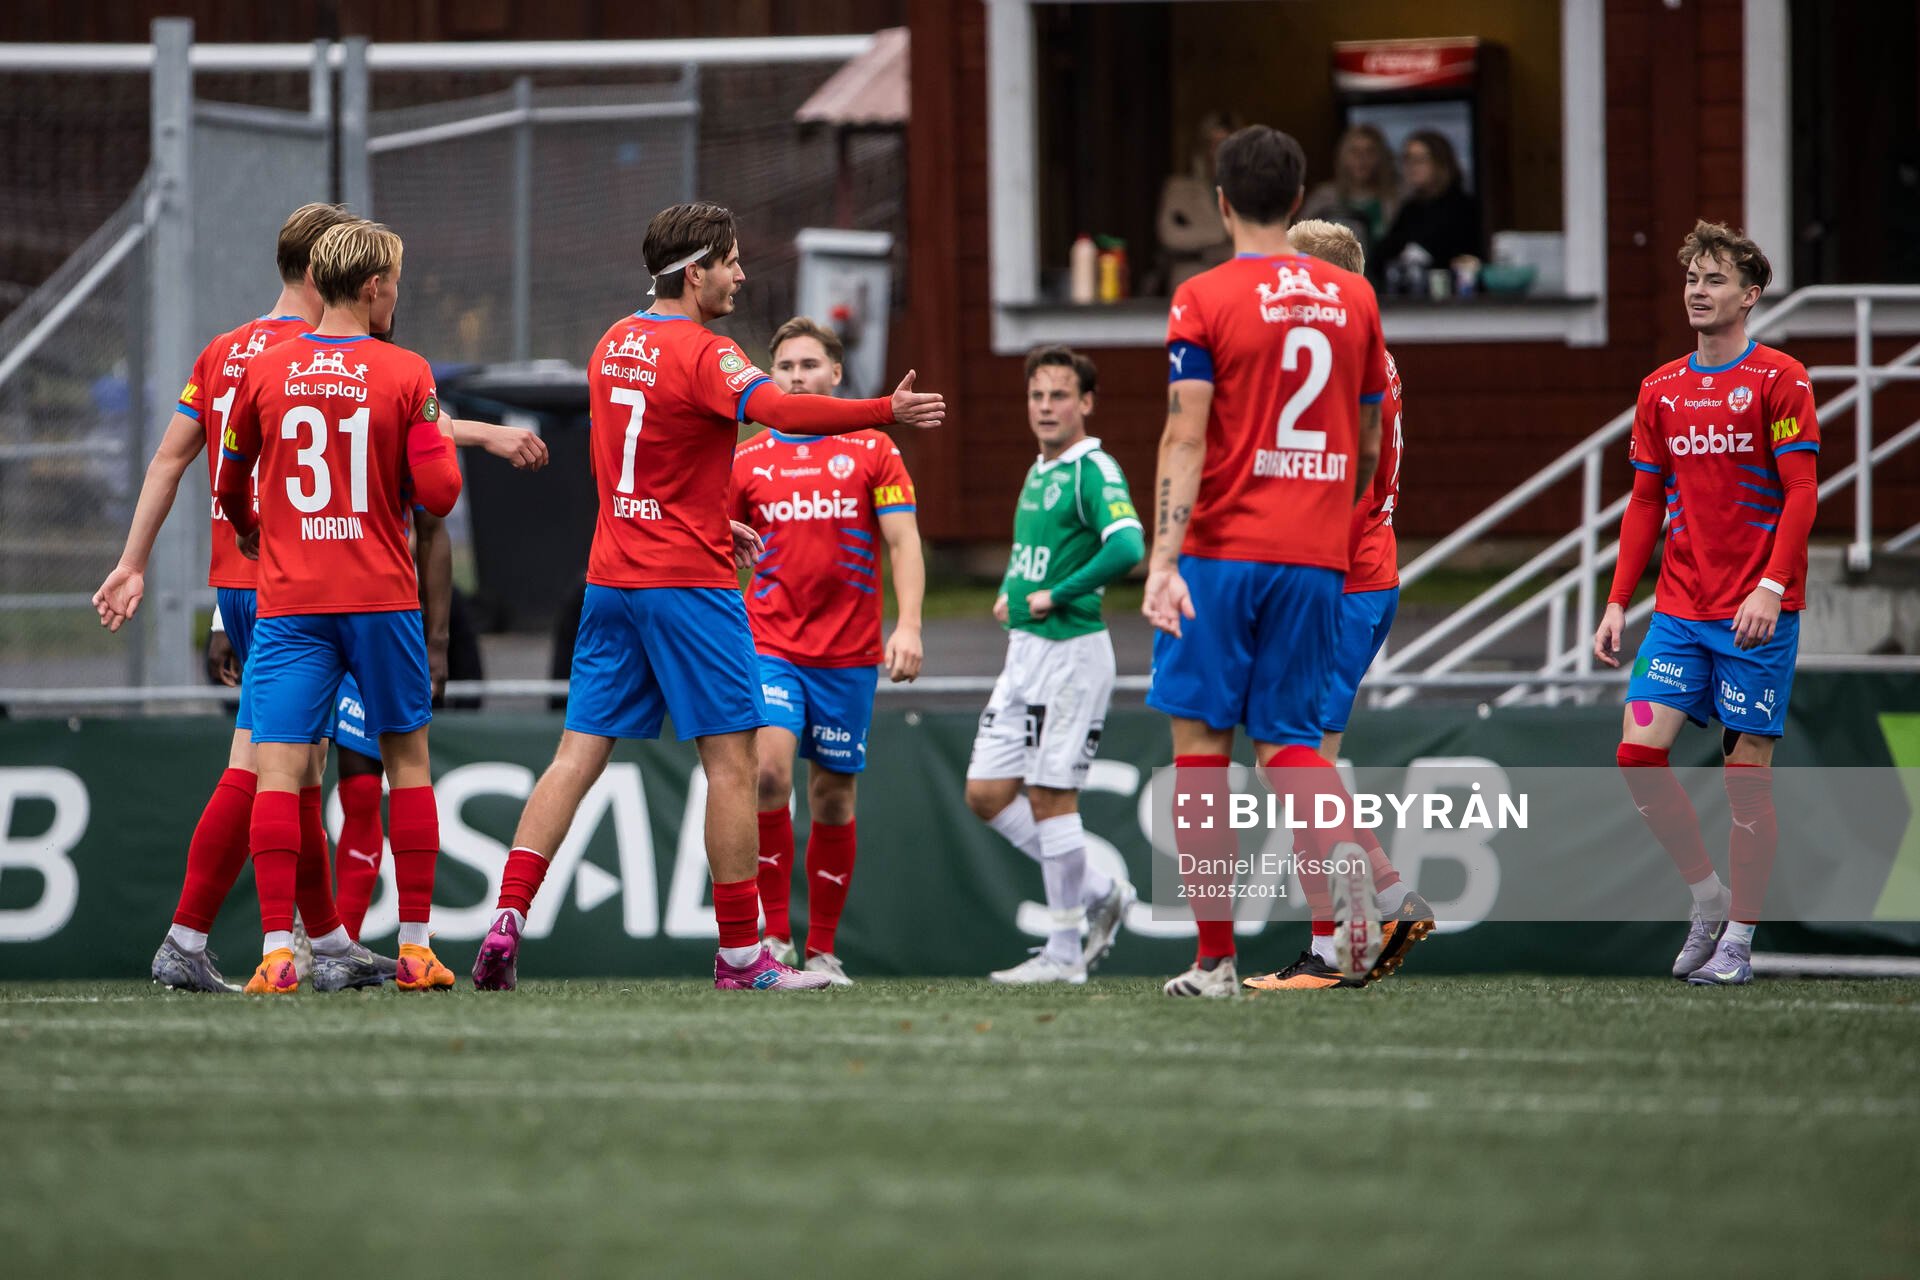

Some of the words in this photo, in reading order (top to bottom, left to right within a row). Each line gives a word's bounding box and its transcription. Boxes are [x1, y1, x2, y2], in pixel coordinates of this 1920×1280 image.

[1260, 303, 1347, 326] letusplay
[601, 360, 657, 387] letusplay
[284, 381, 368, 402] letusplay
[1276, 326, 1333, 452] 2
[609, 386, 646, 494] 7
[280, 405, 371, 513] 31
[759, 489, 859, 523] vobbiz
[301, 516, 364, 541] NORDIN
[1649, 658, 1684, 679] Solid
[1647, 670, 1688, 693] Försäkring
[1763, 688, 1776, 703] 16
[811, 724, 852, 743] Fibio
